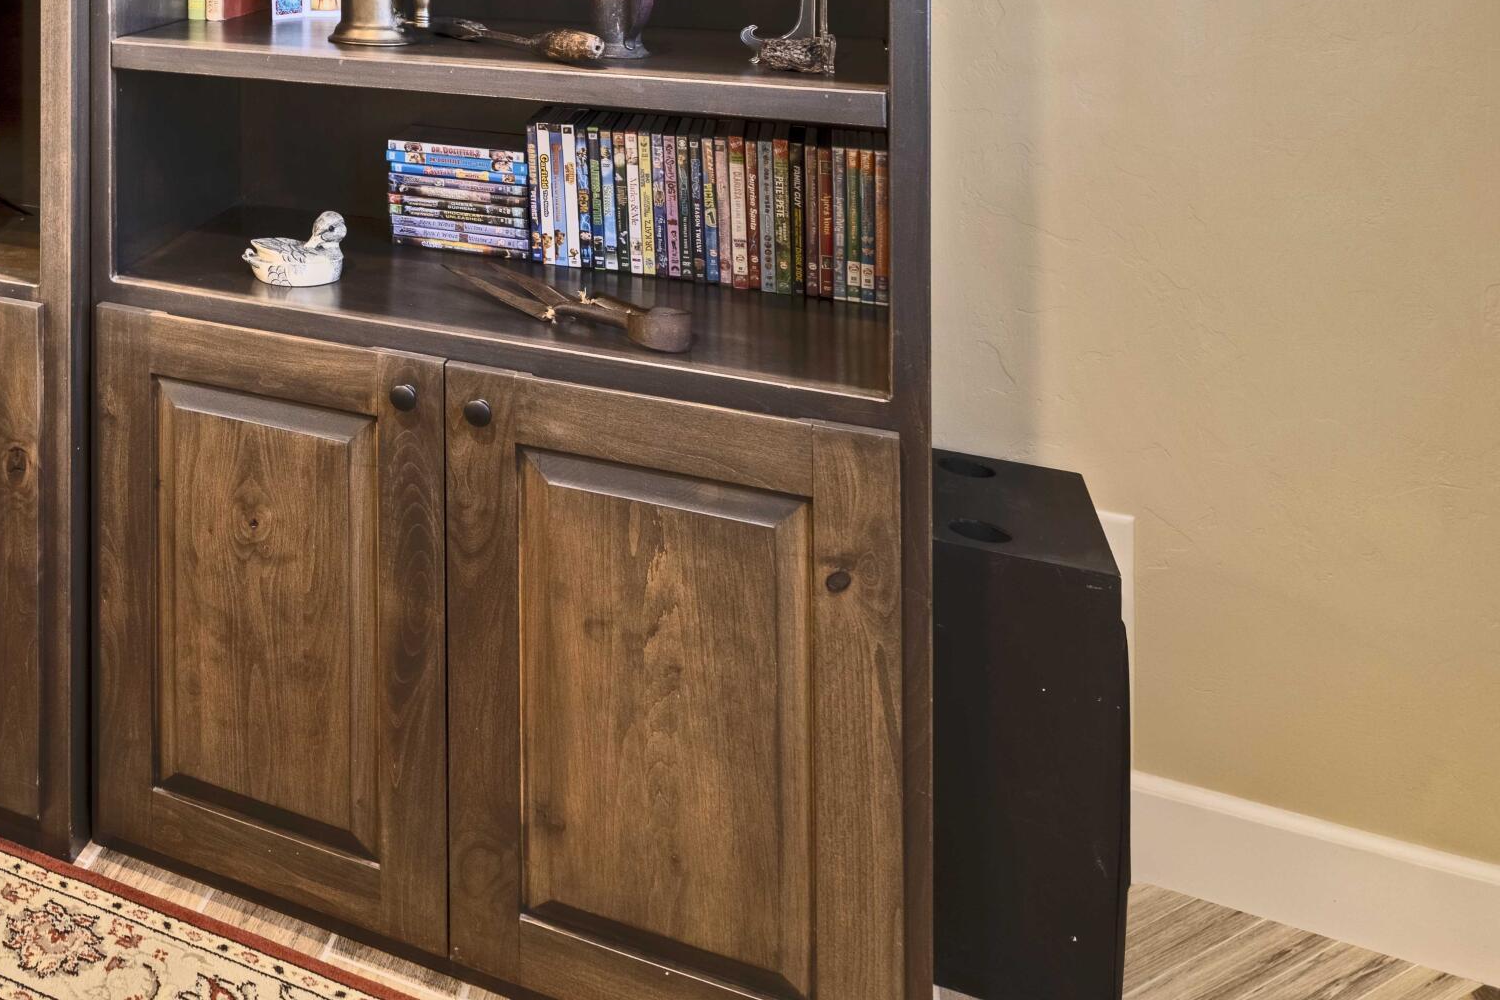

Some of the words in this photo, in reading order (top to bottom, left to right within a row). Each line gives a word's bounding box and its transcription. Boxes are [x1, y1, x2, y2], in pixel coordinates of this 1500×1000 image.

[540, 154, 549, 189] Garfield
[748, 173, 757, 206] Surprise
[775, 176, 784, 194] PETE
[776, 200, 785, 218] PETE
[794, 192, 802, 208] GUY
[750, 208, 758, 230] Santa
